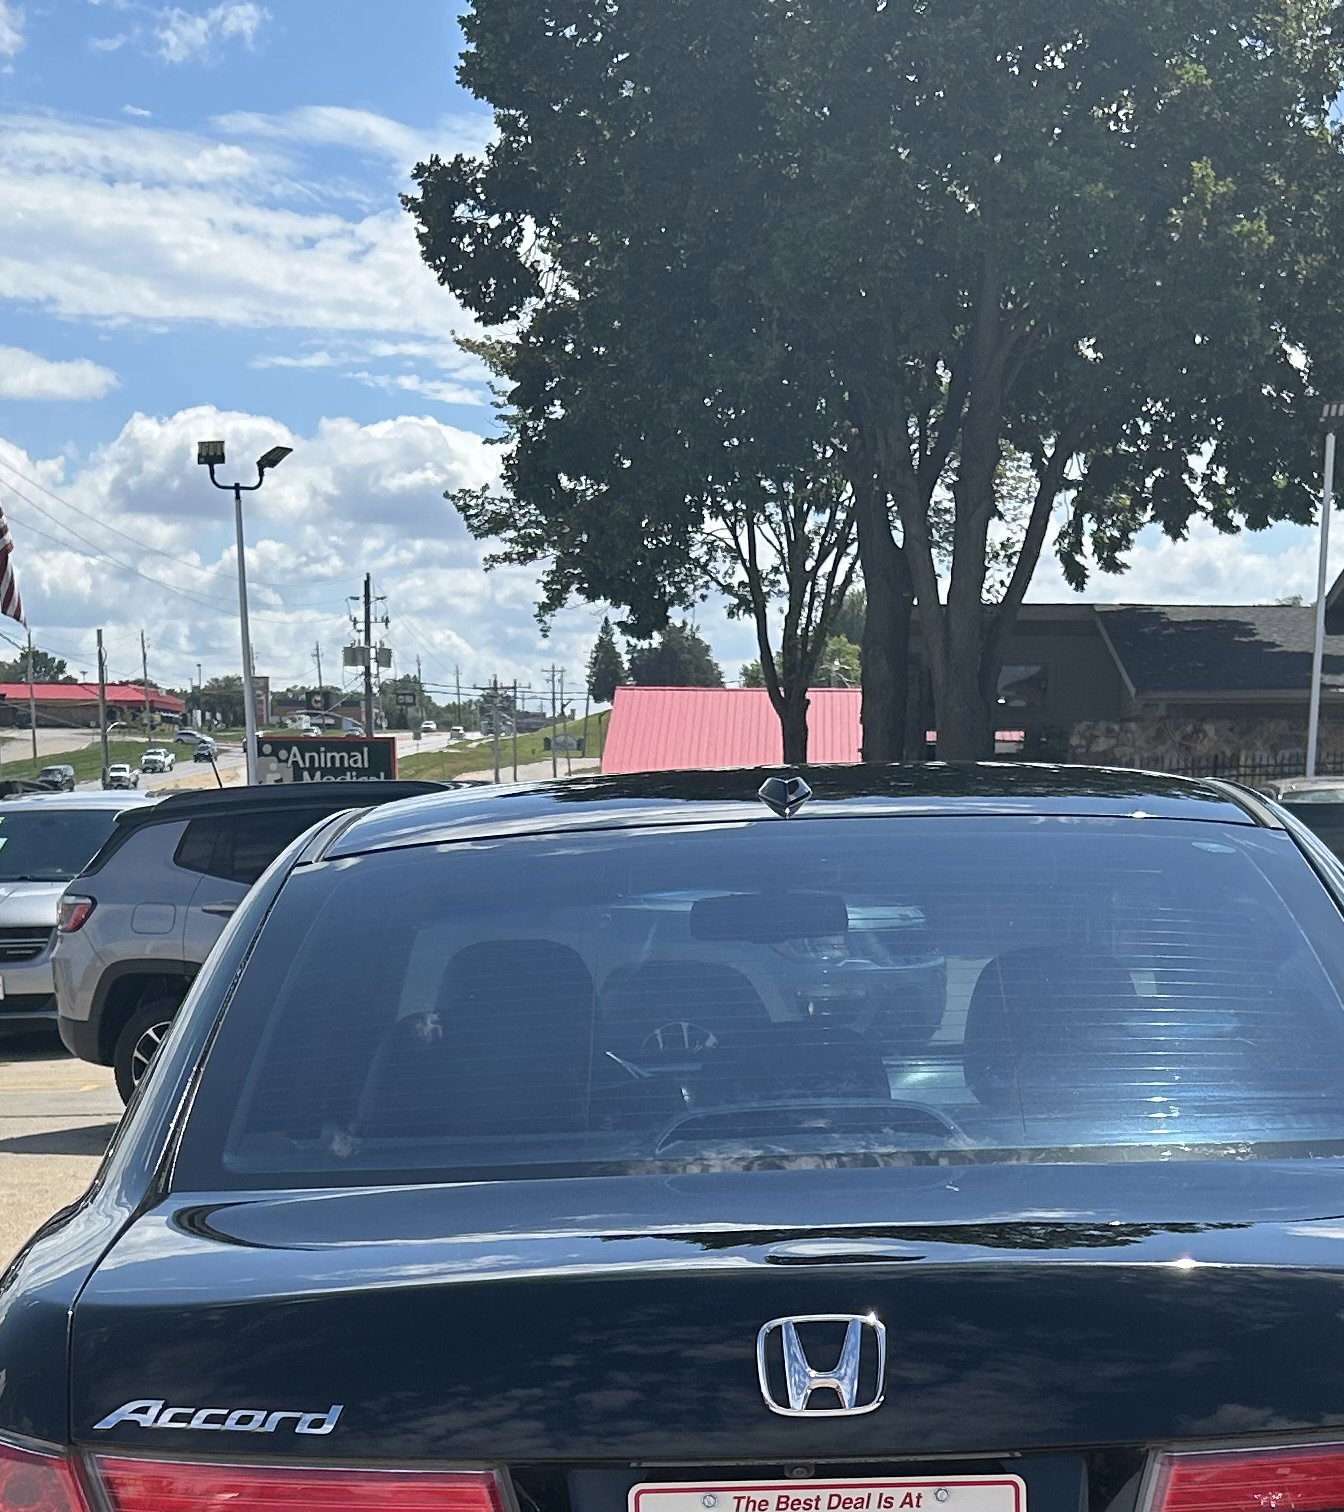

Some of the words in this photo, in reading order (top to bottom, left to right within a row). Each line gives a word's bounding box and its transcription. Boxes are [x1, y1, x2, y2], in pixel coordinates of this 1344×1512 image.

[287, 746, 369, 768] Animal
[93, 1399, 344, 1435] Accord
[732, 1495, 769, 1512] The
[774, 1494, 822, 1512] Best
[826, 1492, 872, 1511] Deal
[876, 1492, 895, 1510] Is
[898, 1491, 923, 1509] At
